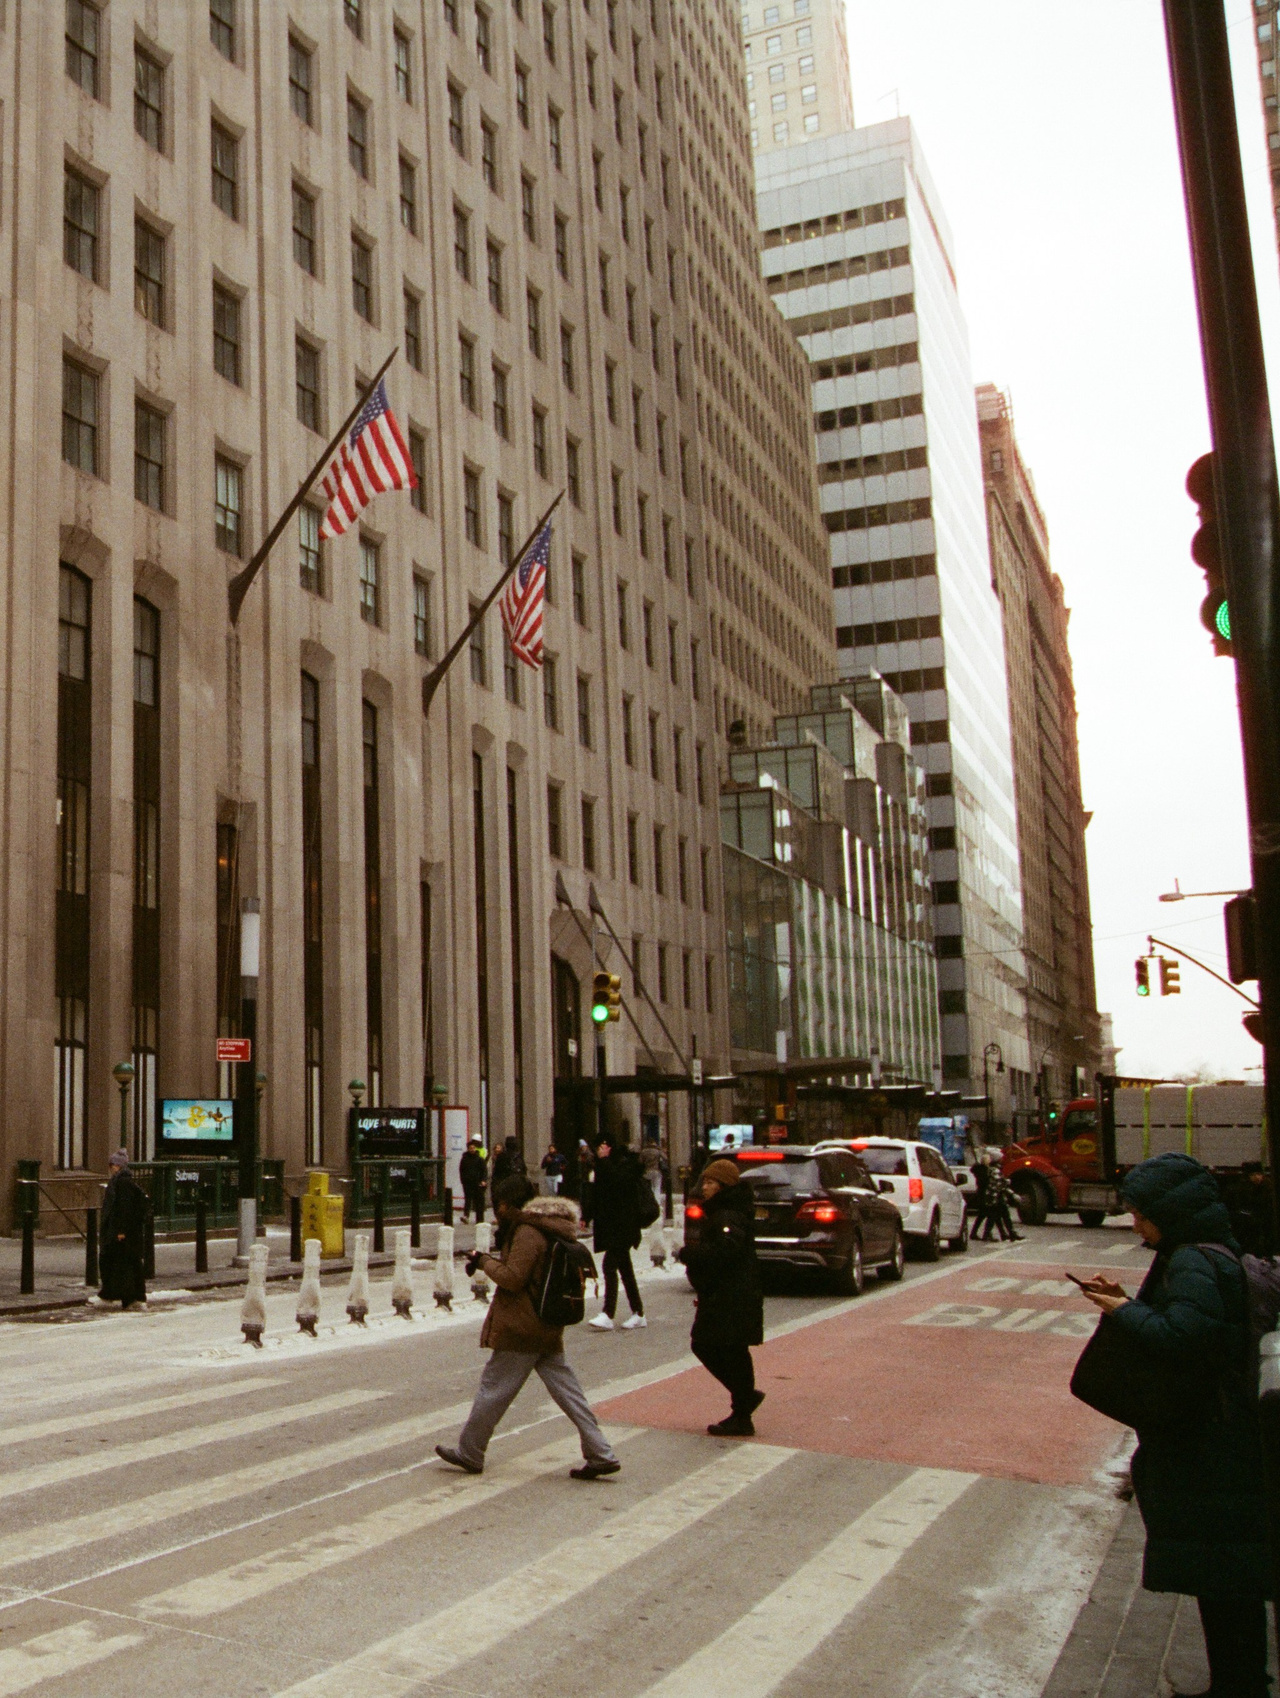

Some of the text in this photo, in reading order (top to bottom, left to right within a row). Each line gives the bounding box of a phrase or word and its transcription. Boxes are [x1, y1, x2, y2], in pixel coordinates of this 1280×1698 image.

[358, 1118, 418, 1129] LOVE HURTS
[175, 1170, 200, 1182] Subway
[900, 1303, 1102, 1338] BUS
